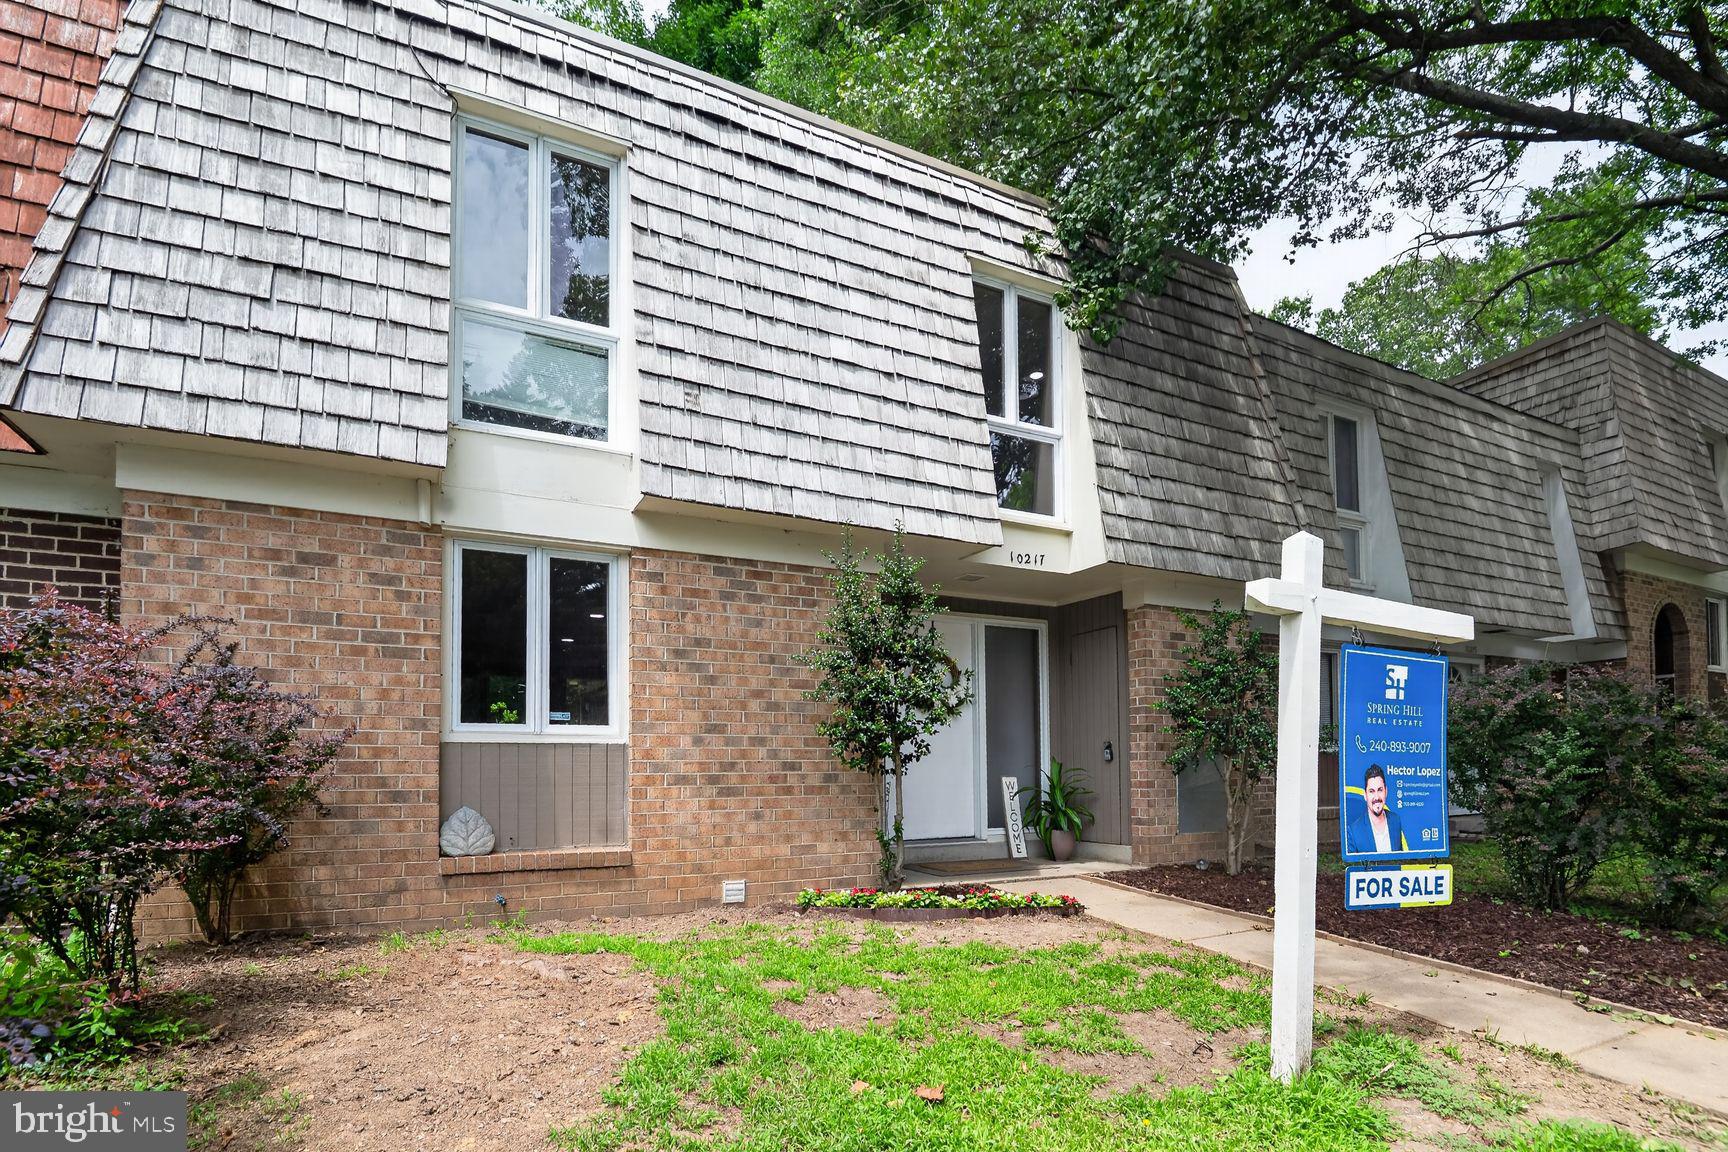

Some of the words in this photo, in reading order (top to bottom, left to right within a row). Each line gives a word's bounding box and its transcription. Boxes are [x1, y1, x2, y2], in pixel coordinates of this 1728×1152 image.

[1010, 551, 1045, 565] 10217
[1367, 702, 1400, 715] SPRING
[1403, 704, 1423, 716] HILL
[1367, 717, 1388, 725] REAL
[1393, 719, 1423, 727] ESTATE
[1369, 740, 1431, 754] 240-893-9007
[1387, 765, 1415, 776] Hector
[1417, 766, 1441, 778] Lopez
[1005, 781, 1022, 854] WELCOME
[1355, 877, 1393, 899] FOR
[1399, 876, 1445, 897] SALE
